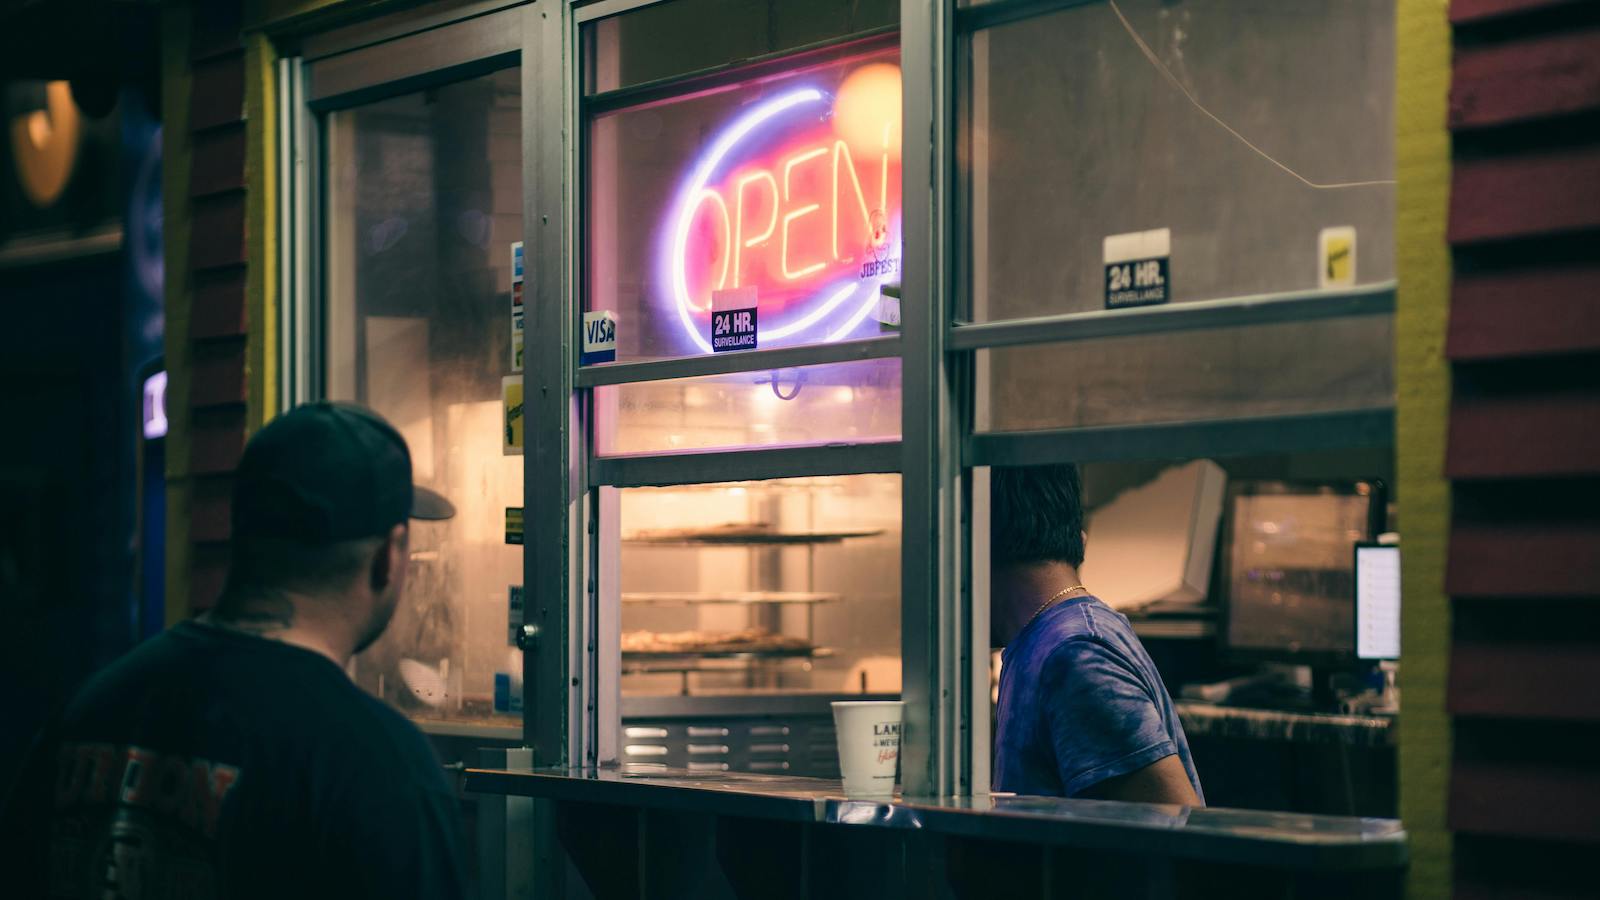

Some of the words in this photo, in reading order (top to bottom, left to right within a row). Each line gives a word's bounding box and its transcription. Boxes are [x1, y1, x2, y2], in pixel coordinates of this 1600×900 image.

[683, 122, 892, 312] OPEN
[861, 258, 899, 278] JIBFEST
[1109, 265, 1131, 291] 24
[1135, 260, 1165, 287] HR.
[586, 318, 615, 344] VISA
[715, 315, 730, 336] 24
[733, 311, 754, 333] HR.
[714, 334, 754, 348] SURVEILLANCE
